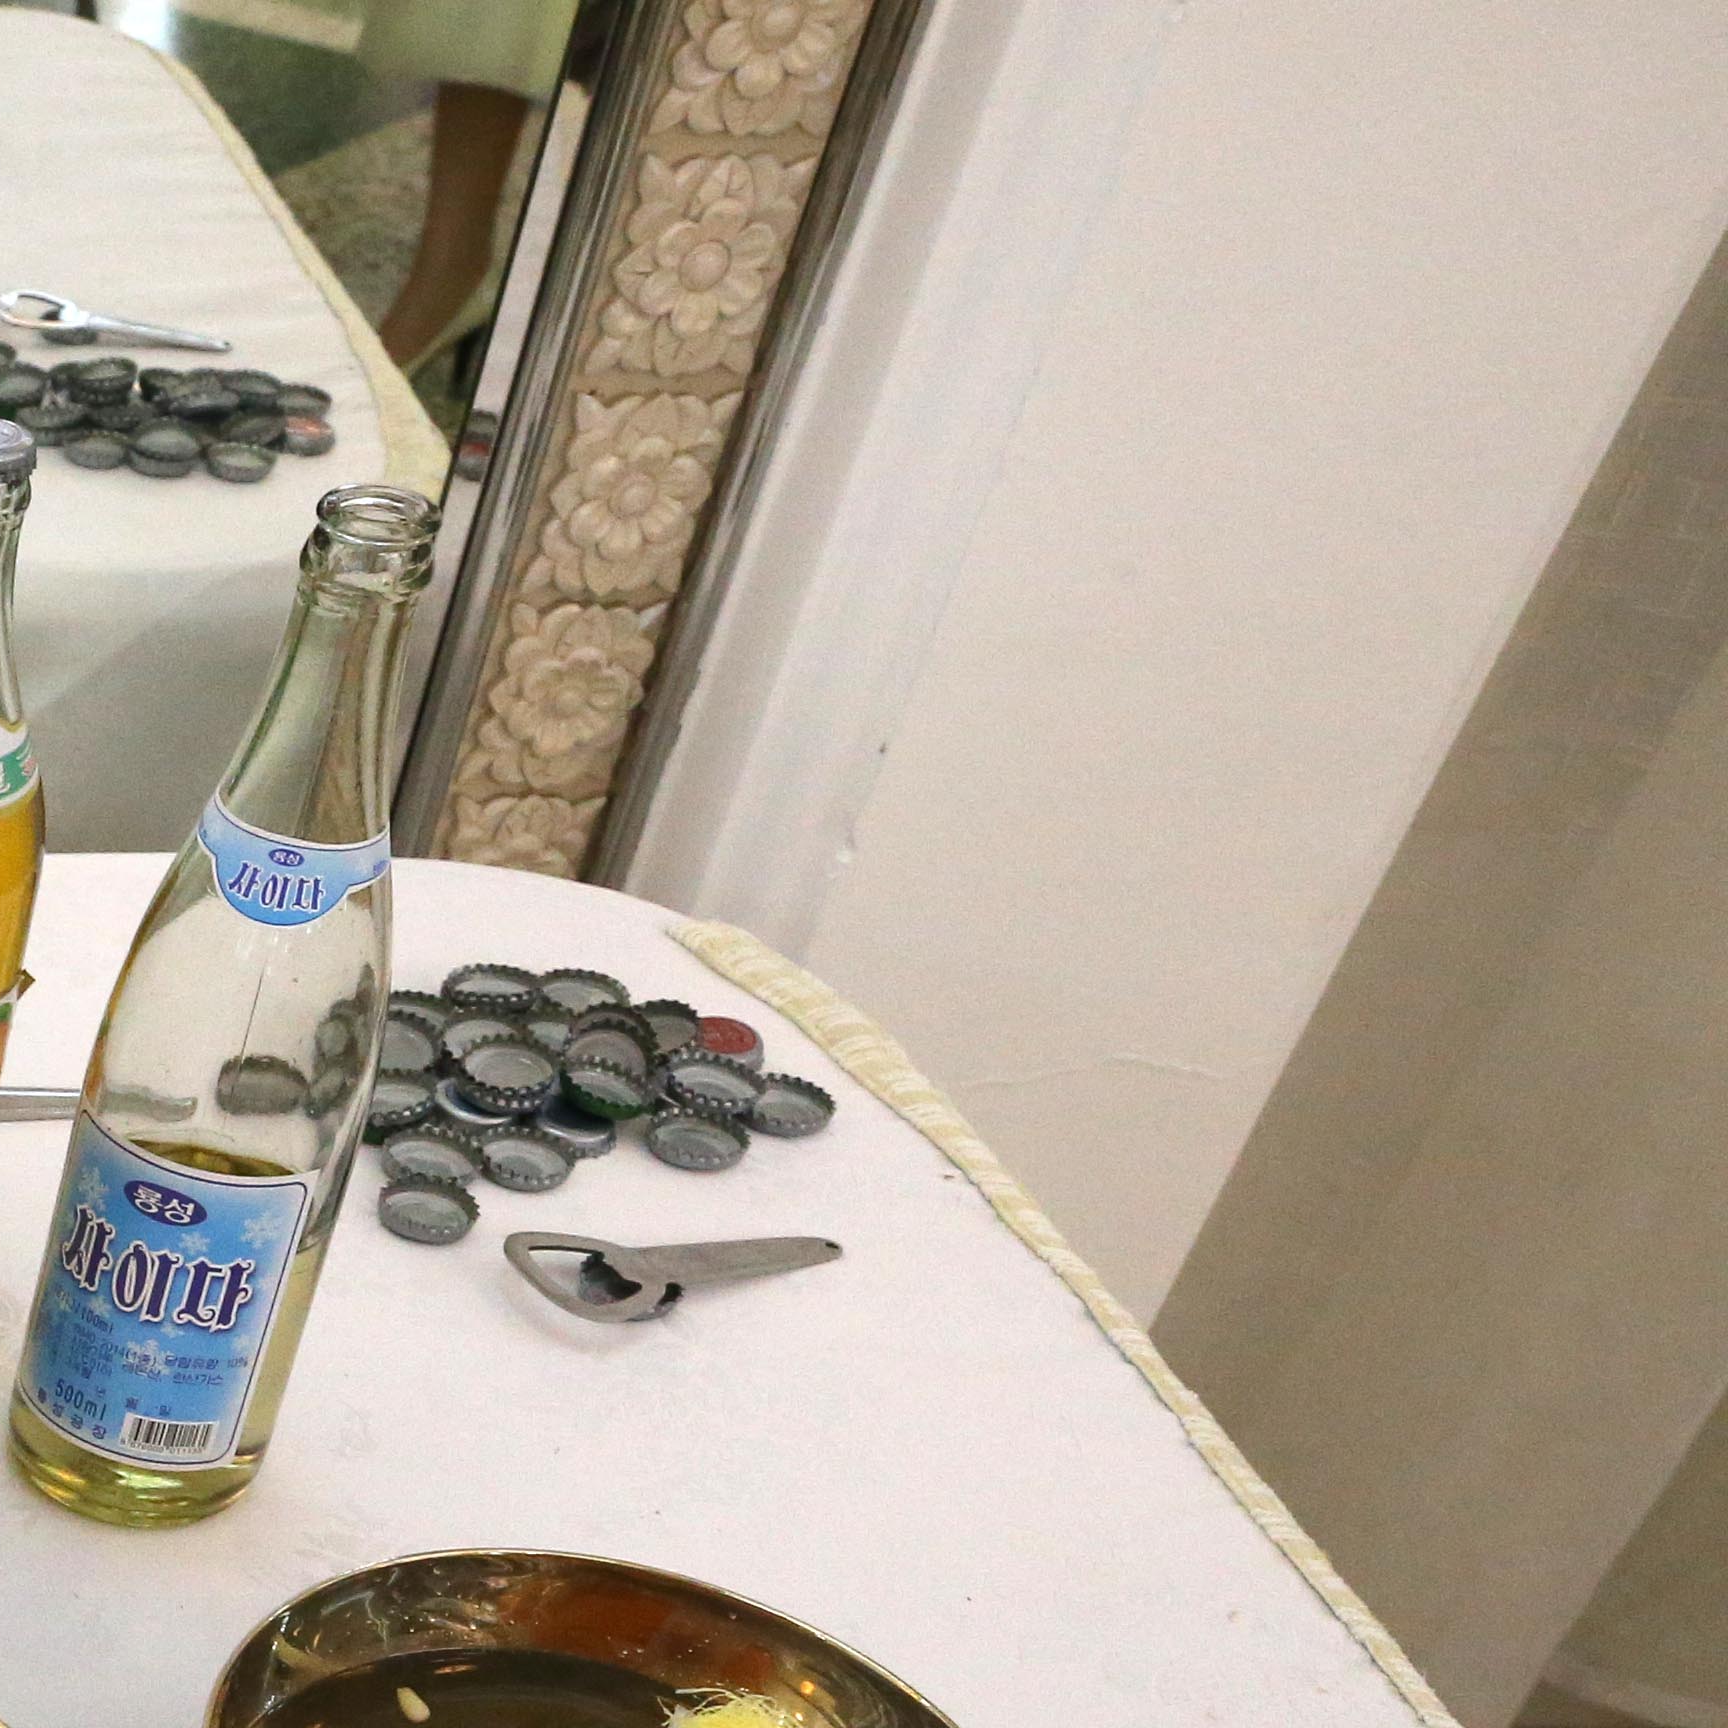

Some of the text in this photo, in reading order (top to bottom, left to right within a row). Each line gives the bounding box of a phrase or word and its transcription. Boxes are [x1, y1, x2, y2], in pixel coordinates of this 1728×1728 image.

[227, 861, 326, 911] 사이다
[134, 1184, 195, 1224] 룡성
[62, 1205, 255, 1333] 사이다
[55, 1378, 106, 1420] 500ml
